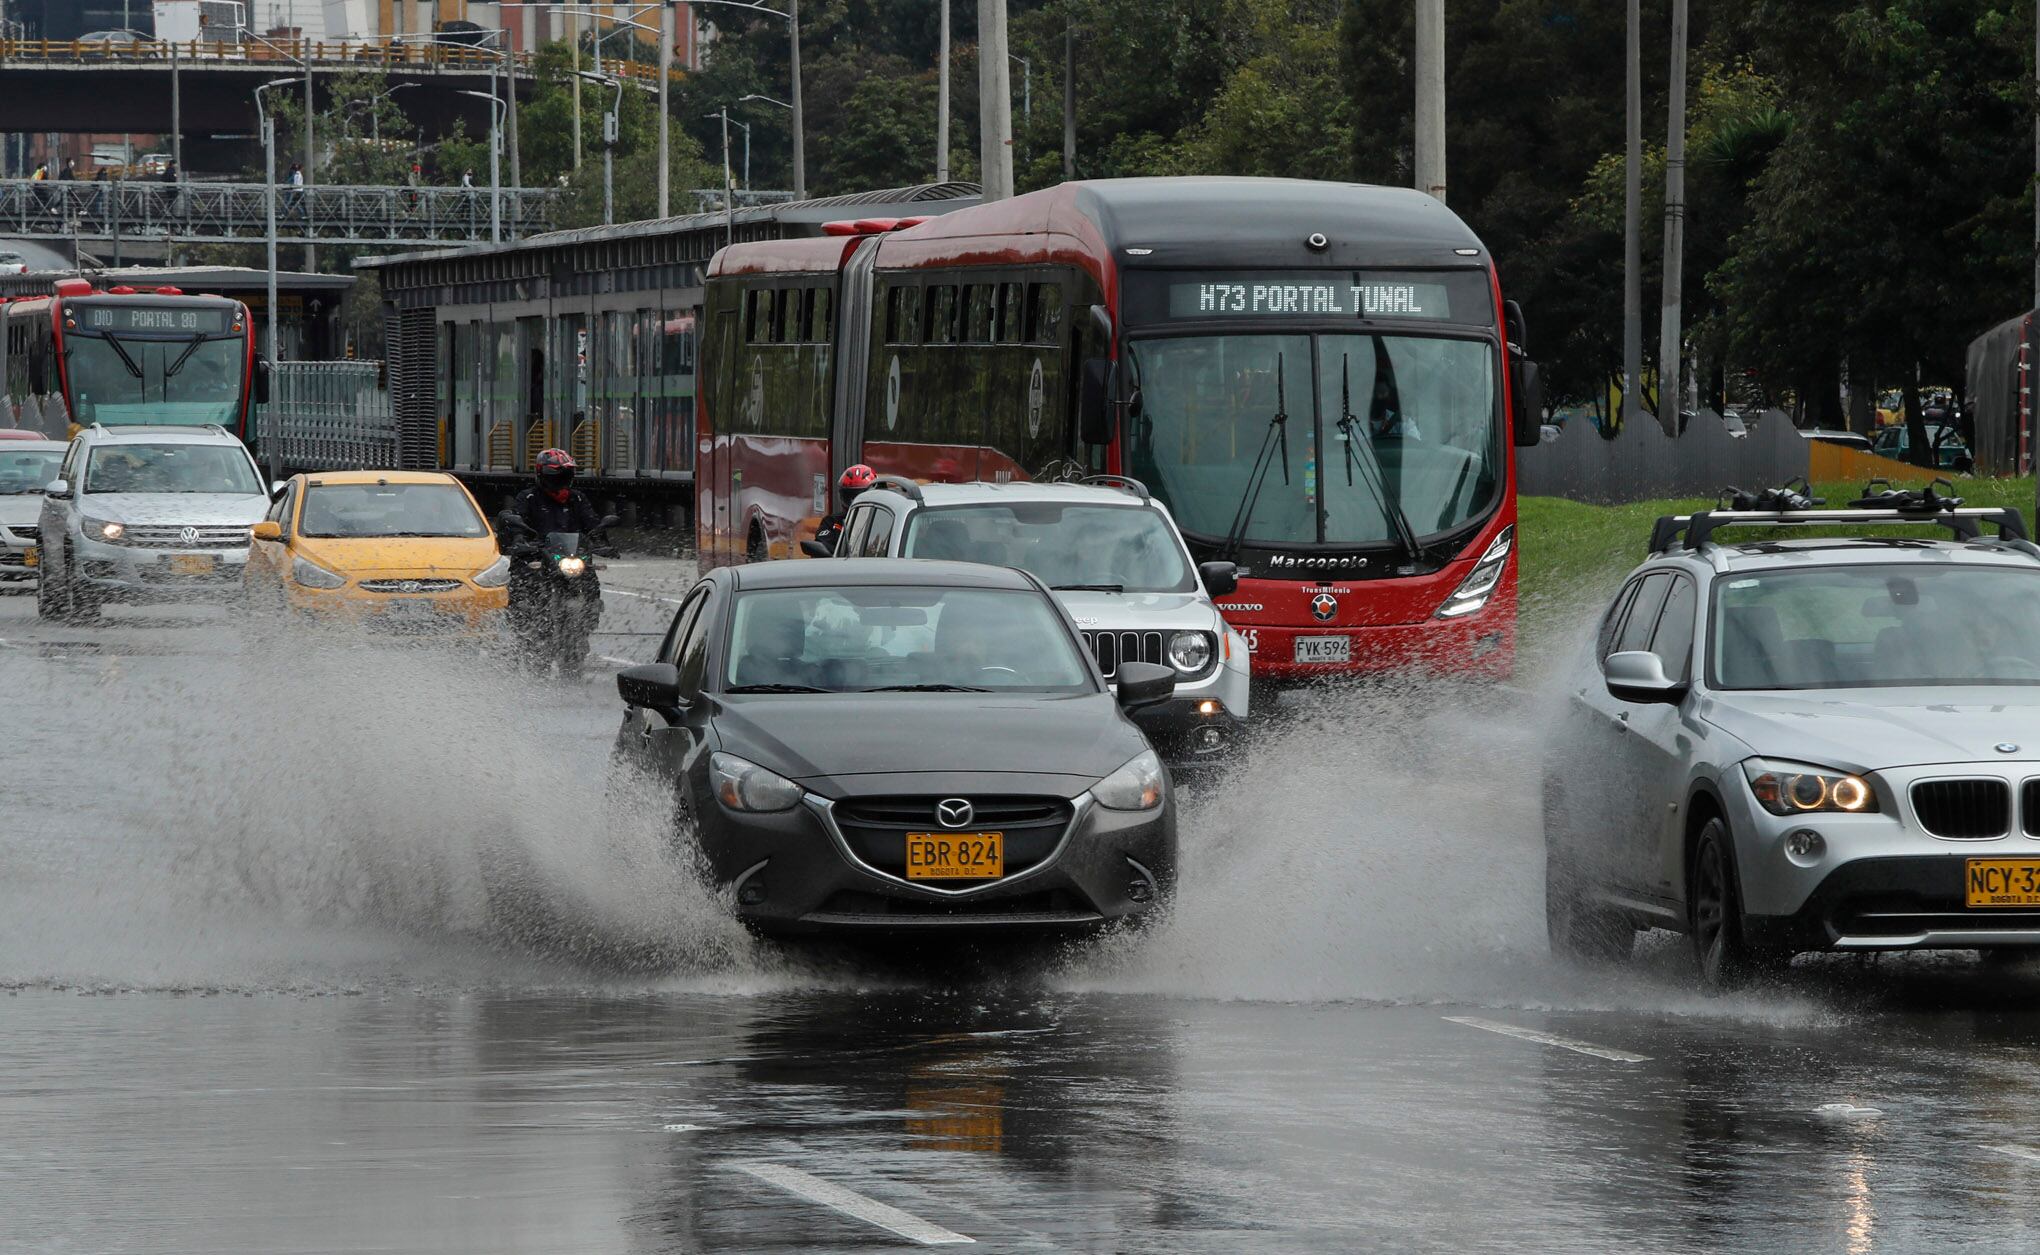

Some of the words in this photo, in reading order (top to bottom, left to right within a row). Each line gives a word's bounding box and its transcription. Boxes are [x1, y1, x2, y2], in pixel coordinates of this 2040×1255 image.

[1200, 284, 1246, 311] H73
[1253, 285, 1342, 312] PORTAL
[1350, 286, 1422, 312] TUNAL
[131, 311, 175, 328] PORTAL
[181, 312, 197, 329] 80
[1270, 555, 1368, 570] Marcopolo
[1302, 586, 1351, 594] TransMilenio
[1217, 603, 1264, 611] VOLVO
[1073, 616, 1098, 626] eep
[910, 841, 951, 866] EBR
[958, 841, 998, 866] 824
